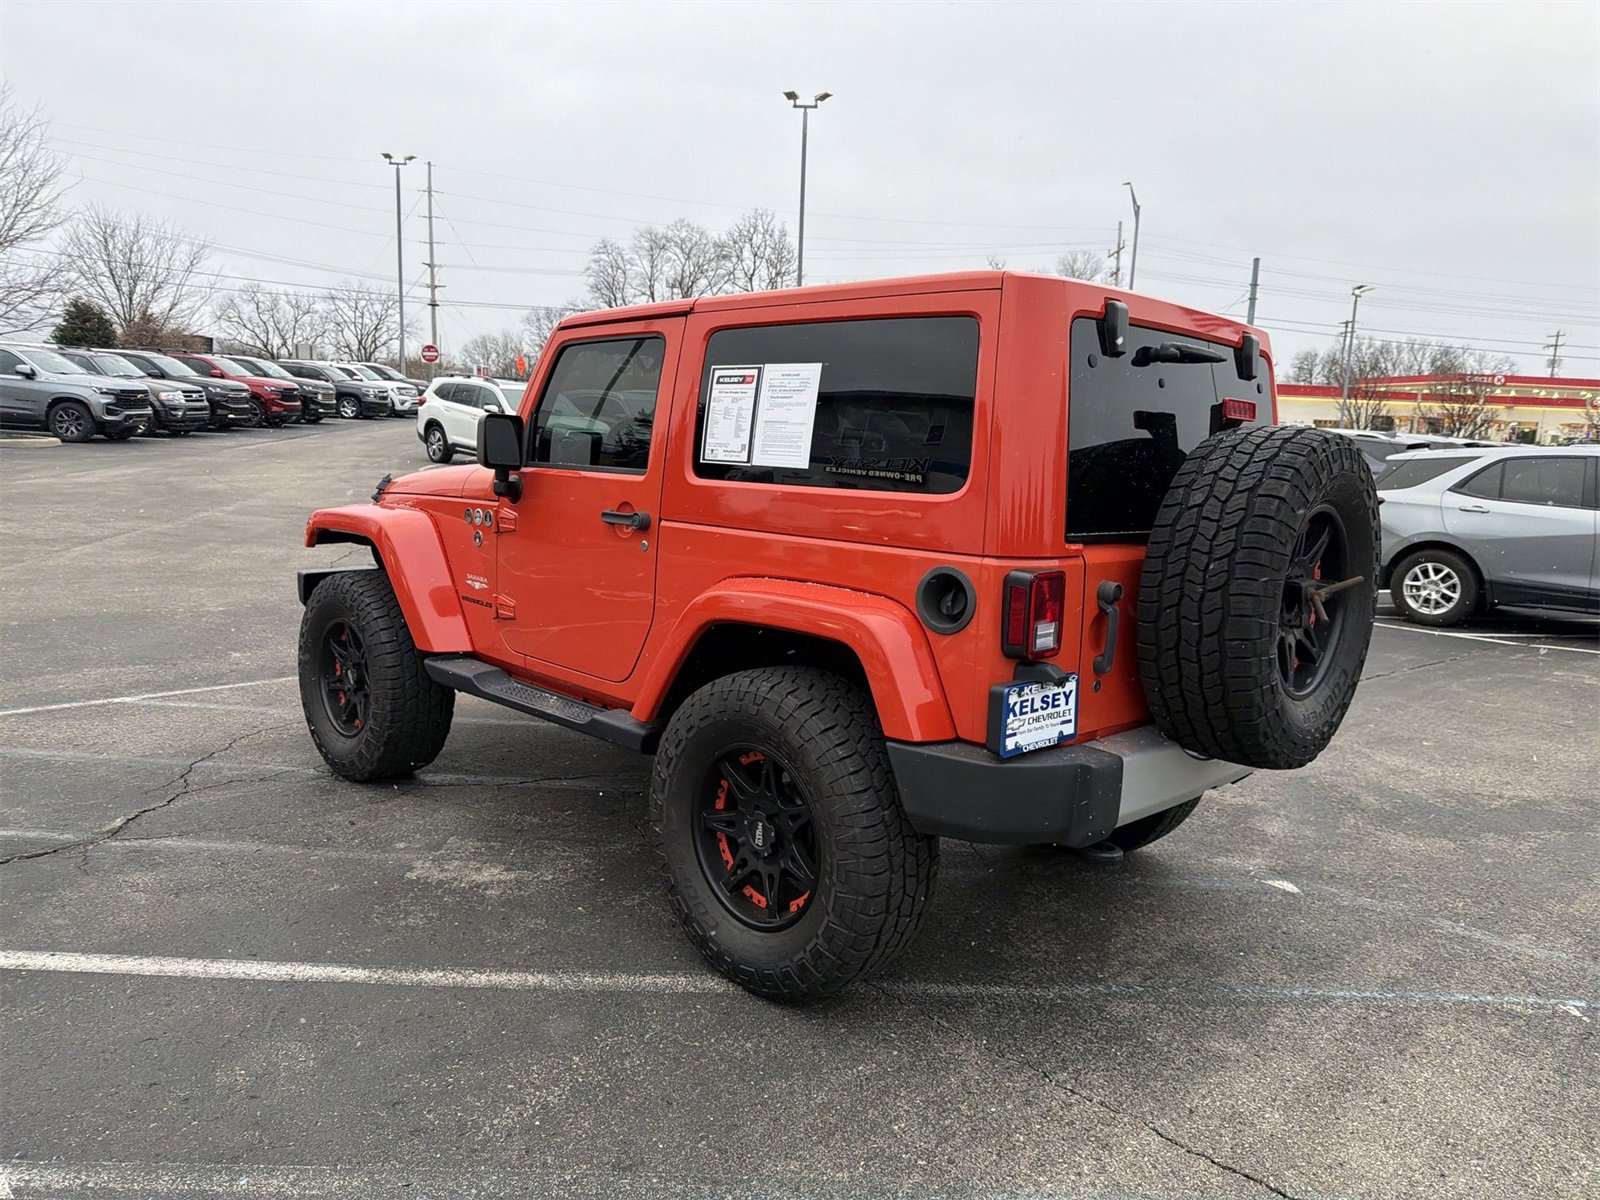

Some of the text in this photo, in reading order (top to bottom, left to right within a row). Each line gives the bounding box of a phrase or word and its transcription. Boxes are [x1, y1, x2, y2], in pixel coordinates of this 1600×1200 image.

[466, 573, 488, 583] SAHARA
[461, 595, 493, 609] WRANGLER
[1302, 668, 1349, 723] COOPER
[1007, 690, 1074, 718] KELSEY
[1027, 708, 1072, 725] CHEVROLET
[1023, 738, 1058, 752] CHEVROLET
